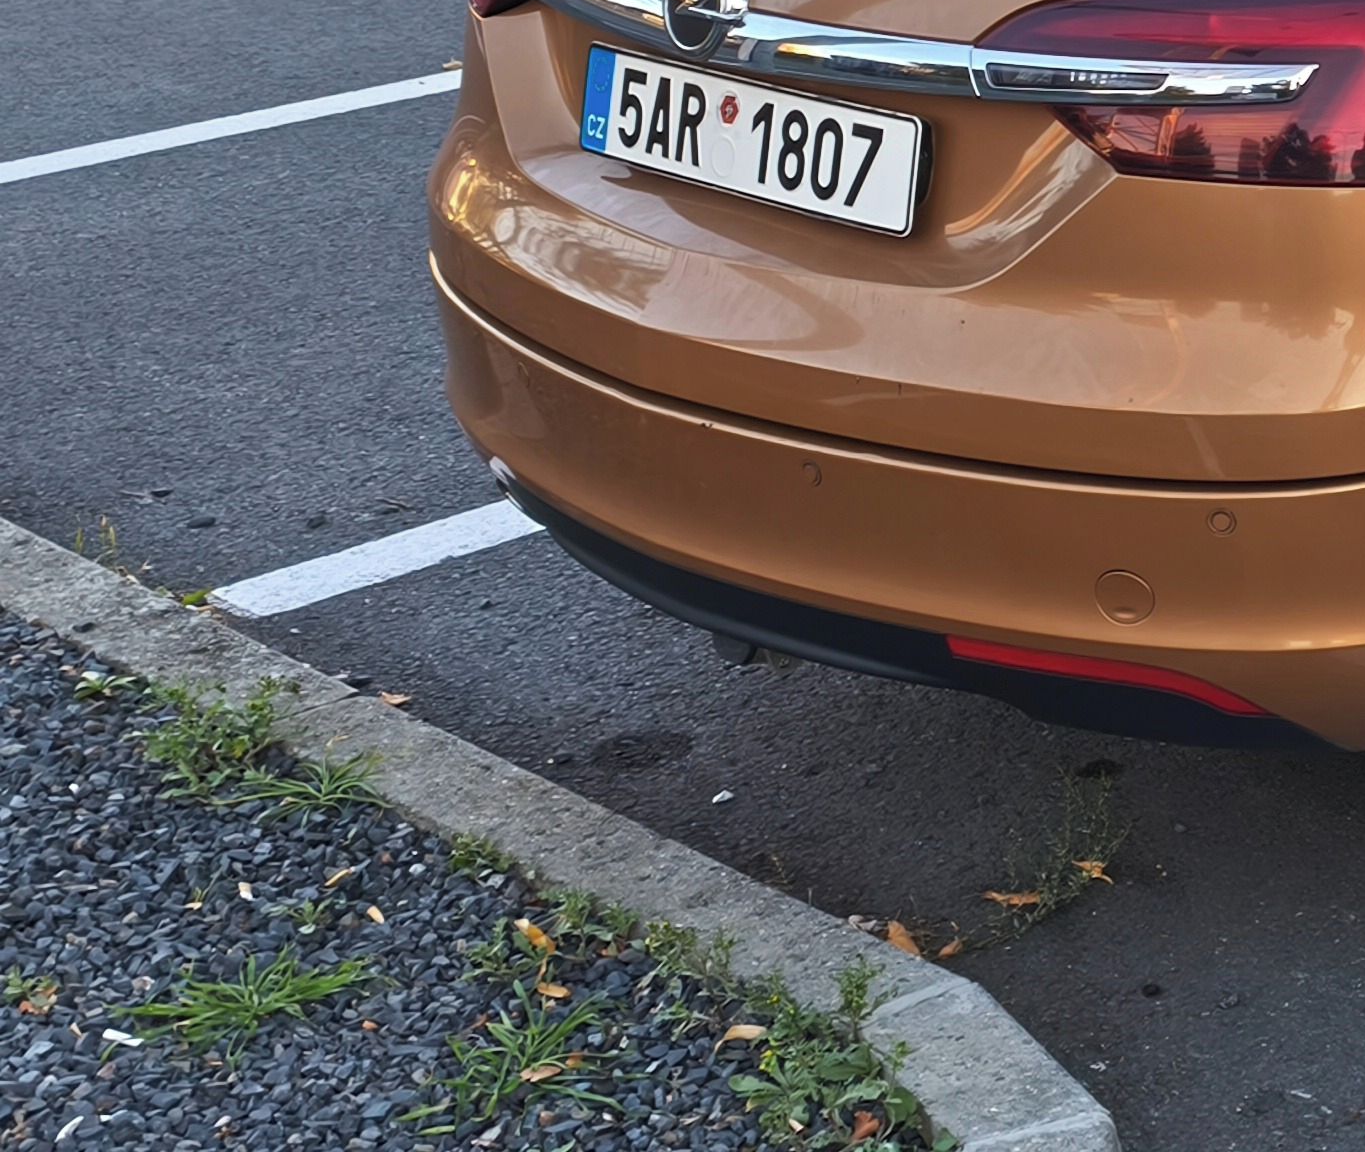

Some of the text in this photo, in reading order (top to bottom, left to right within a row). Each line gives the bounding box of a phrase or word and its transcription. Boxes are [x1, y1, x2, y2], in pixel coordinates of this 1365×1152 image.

[587, 112, 604, 140] CZ
[617, 67, 884, 208] 5AR 1807
